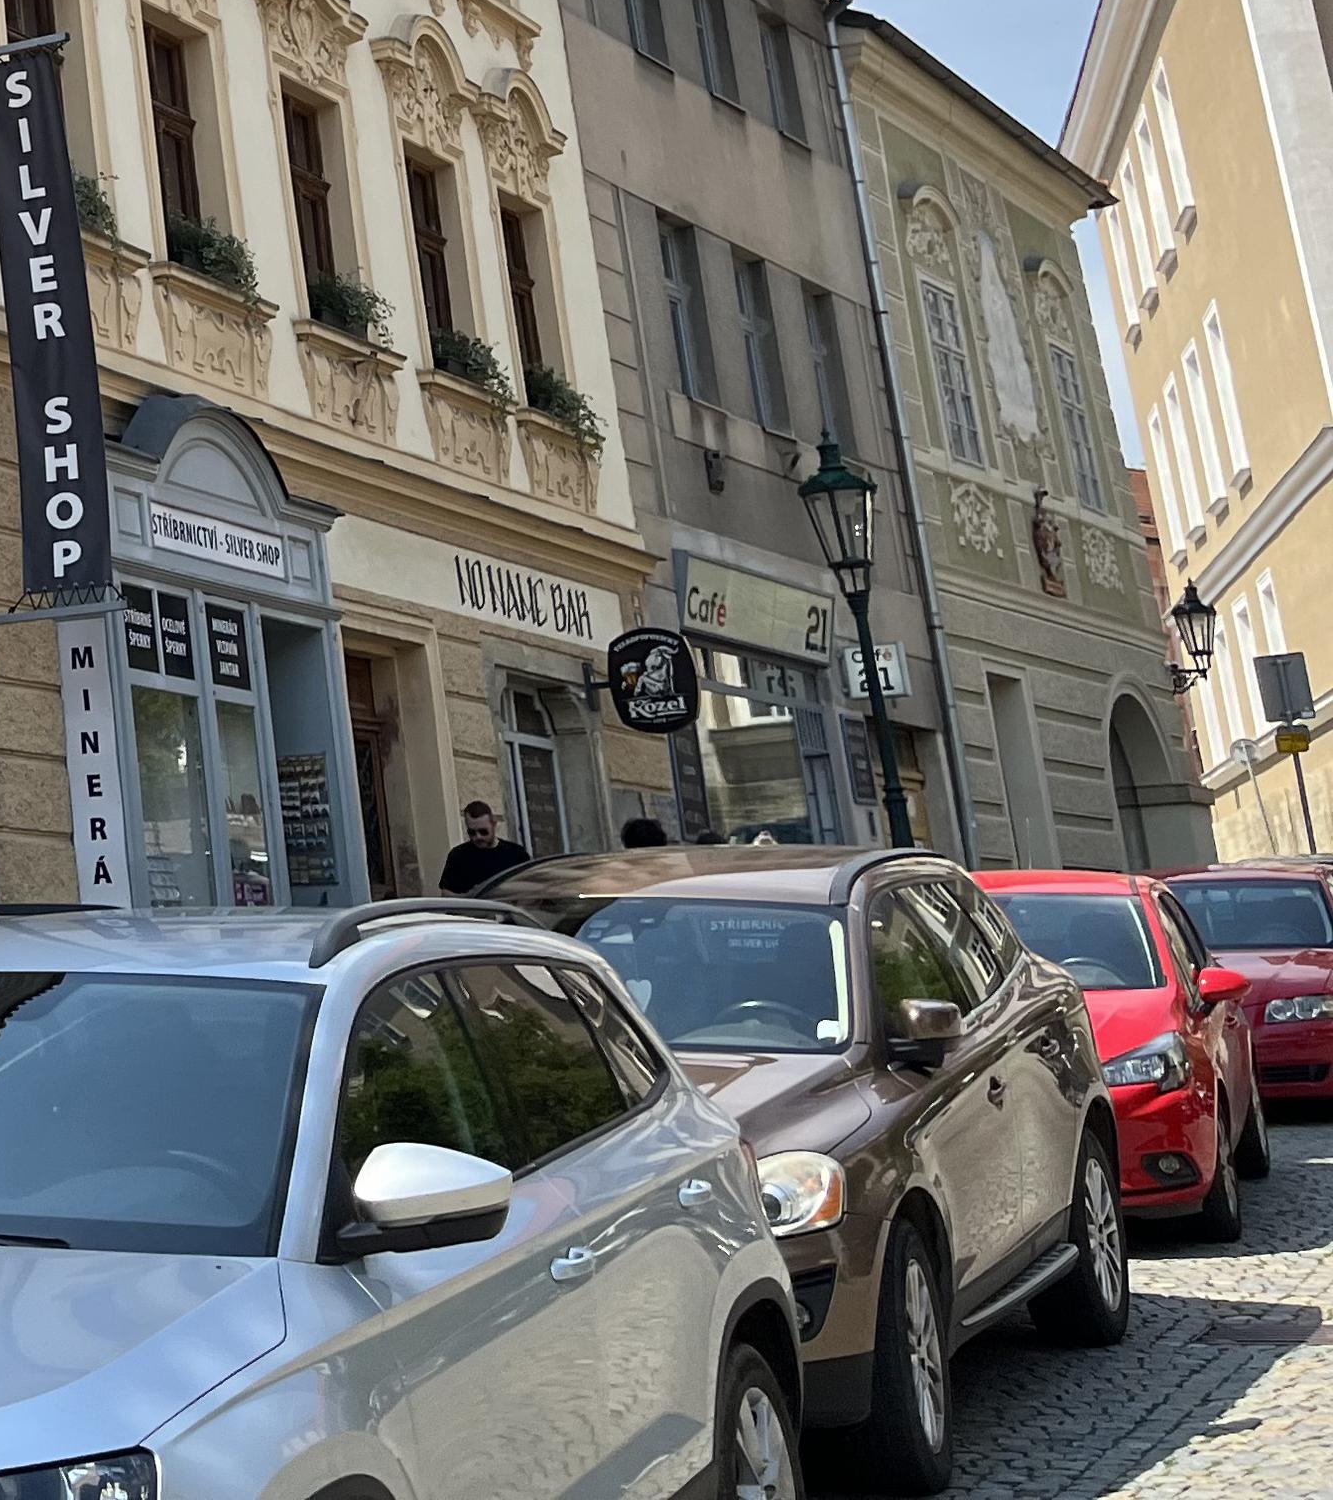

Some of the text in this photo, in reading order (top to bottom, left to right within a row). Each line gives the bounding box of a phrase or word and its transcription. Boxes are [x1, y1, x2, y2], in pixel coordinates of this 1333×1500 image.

[5, 70, 84, 579] SILVER SHOP
[152, 512, 218, 551] STŘÍBRNICTVÍ
[225, 533, 255, 561] SILVER
[256, 542, 280, 566] SHOP
[454, 555, 593, 640] NO NAME BAR
[687, 586, 827, 654] Café 21
[851, 648, 893, 664] Cfé
[629, 696, 687, 718] Kozel
